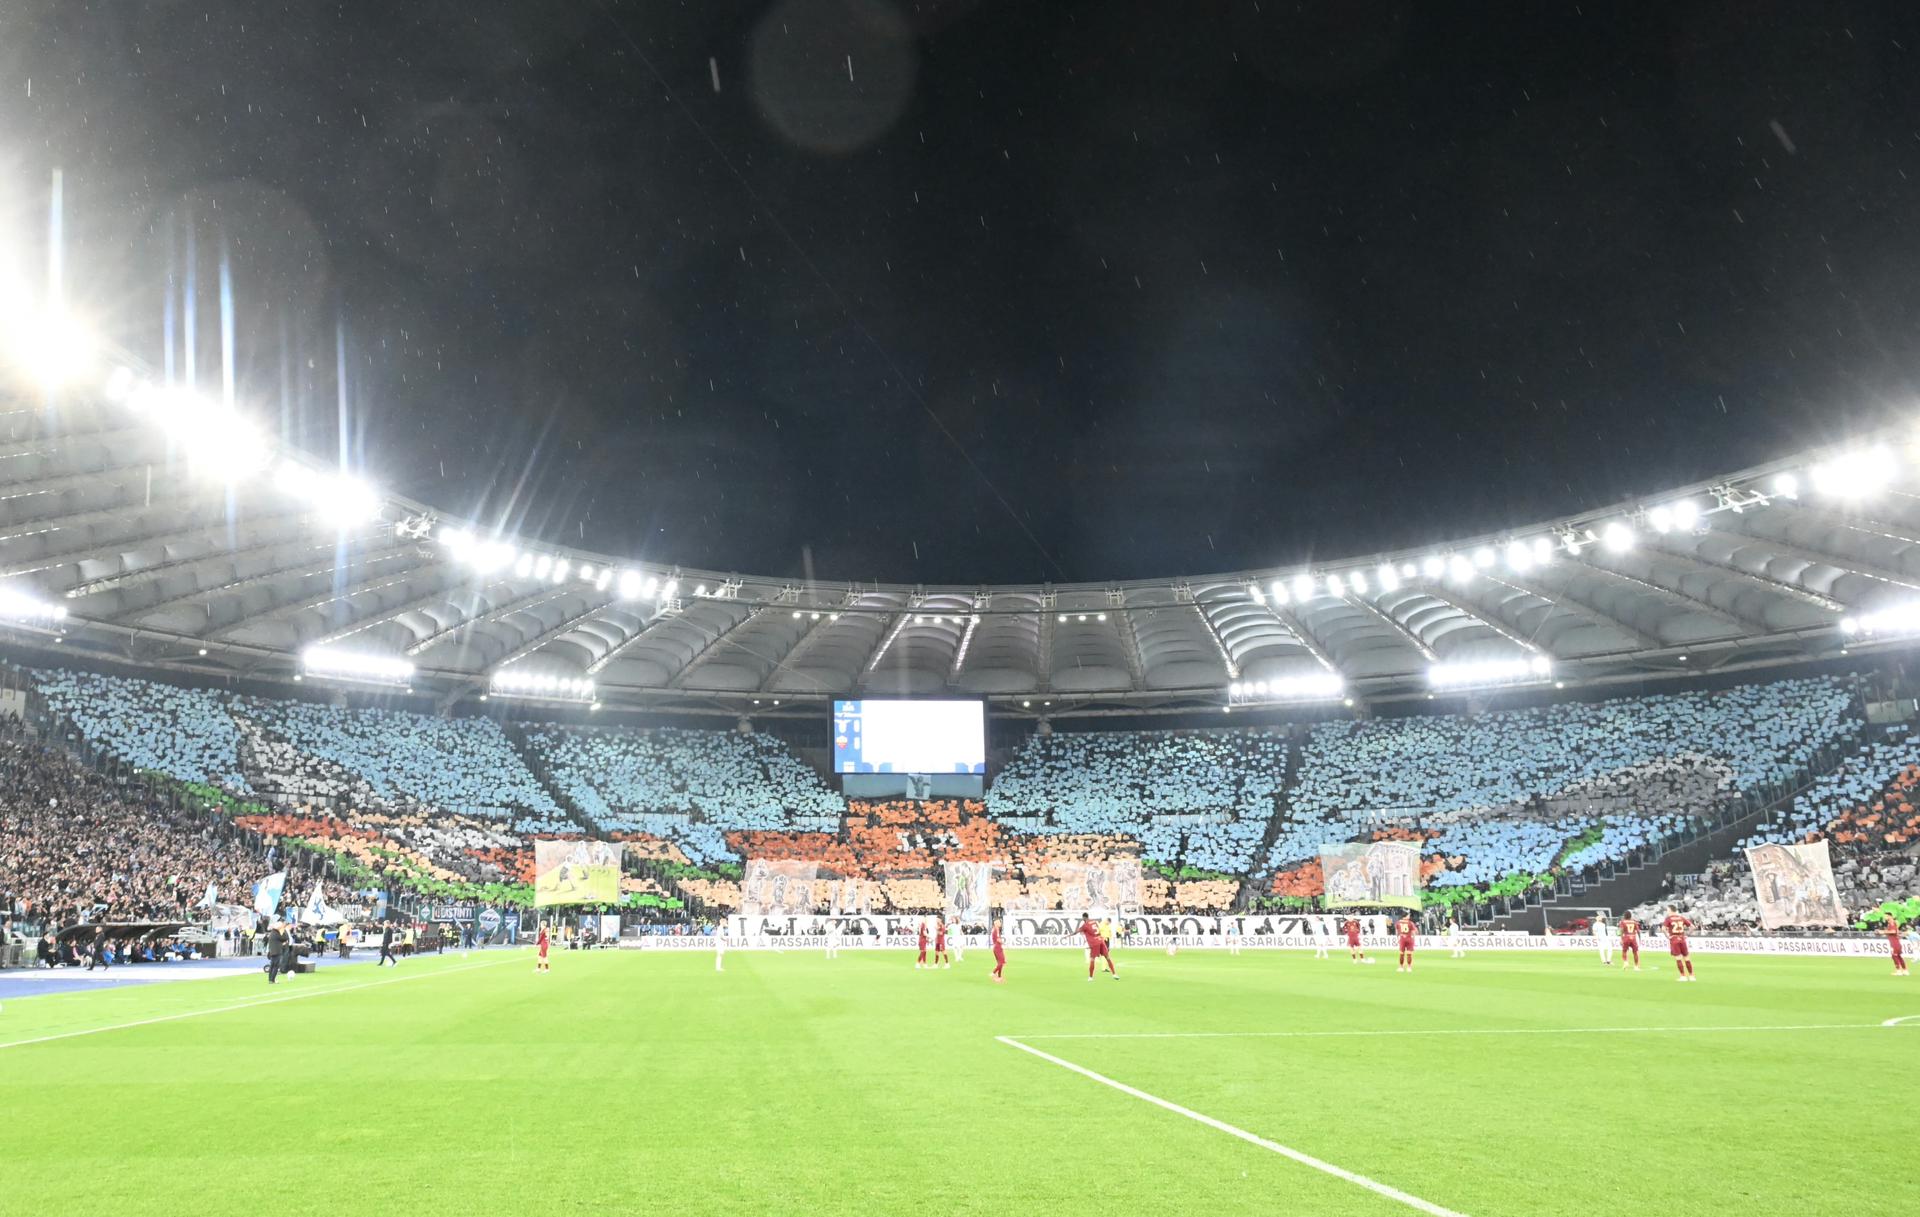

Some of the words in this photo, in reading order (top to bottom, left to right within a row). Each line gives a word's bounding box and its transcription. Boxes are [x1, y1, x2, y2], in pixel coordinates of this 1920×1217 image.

[1091, 924, 1100, 935] 5
[1671, 921, 1685, 934] 23
[656, 937, 748, 947] PASSARI&ILIA
[771, 937, 863, 947] PASSARI&ILIA
[1226, 937, 1317, 947] PSSARI&CILIA
[1705, 941, 1764, 951] PASSARI&CILIA
[1779, 942, 1846, 953] PASSARI&CILIA
